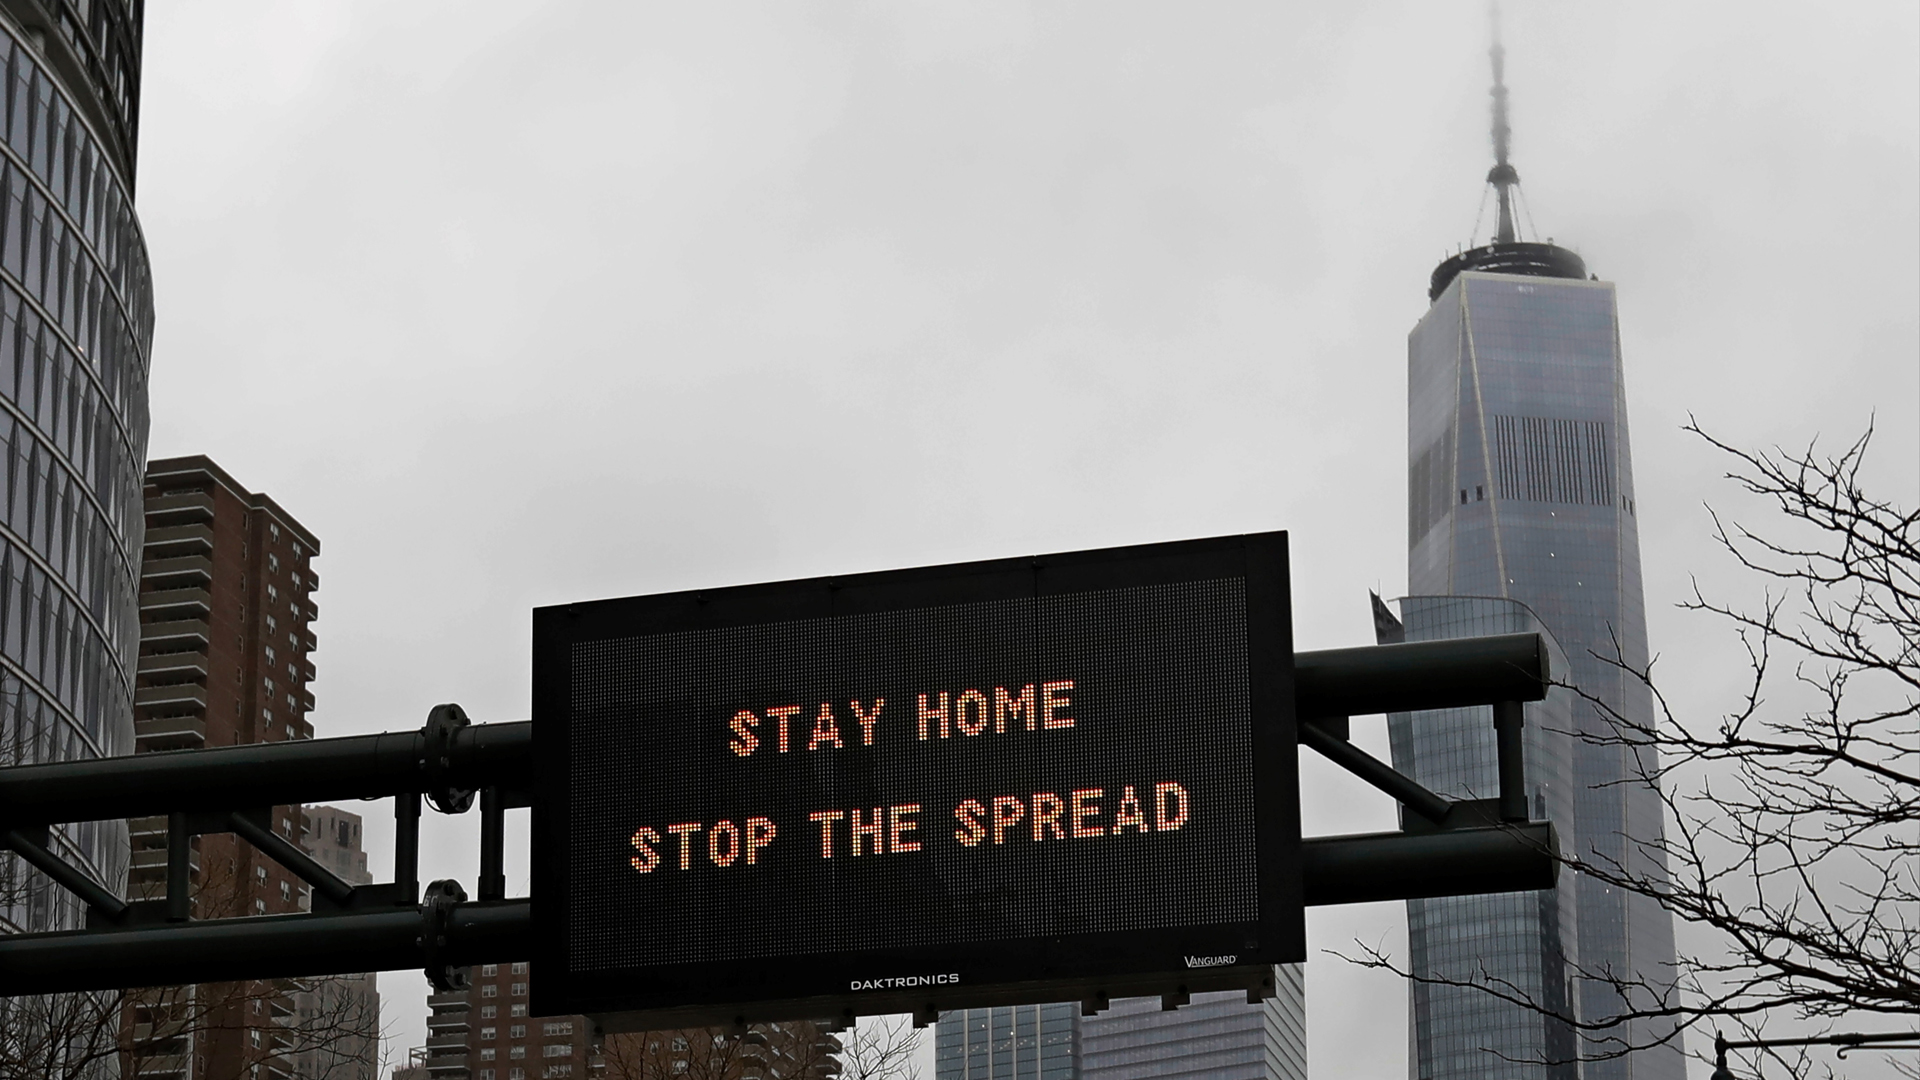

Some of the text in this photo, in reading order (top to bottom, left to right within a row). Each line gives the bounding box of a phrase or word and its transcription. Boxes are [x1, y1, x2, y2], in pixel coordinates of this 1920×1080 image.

[729, 680, 1075, 758] STAY HOME
[631, 782, 1189, 874] STOP THE SPREAD
[850, 973, 960, 991] DAKTRONICS
